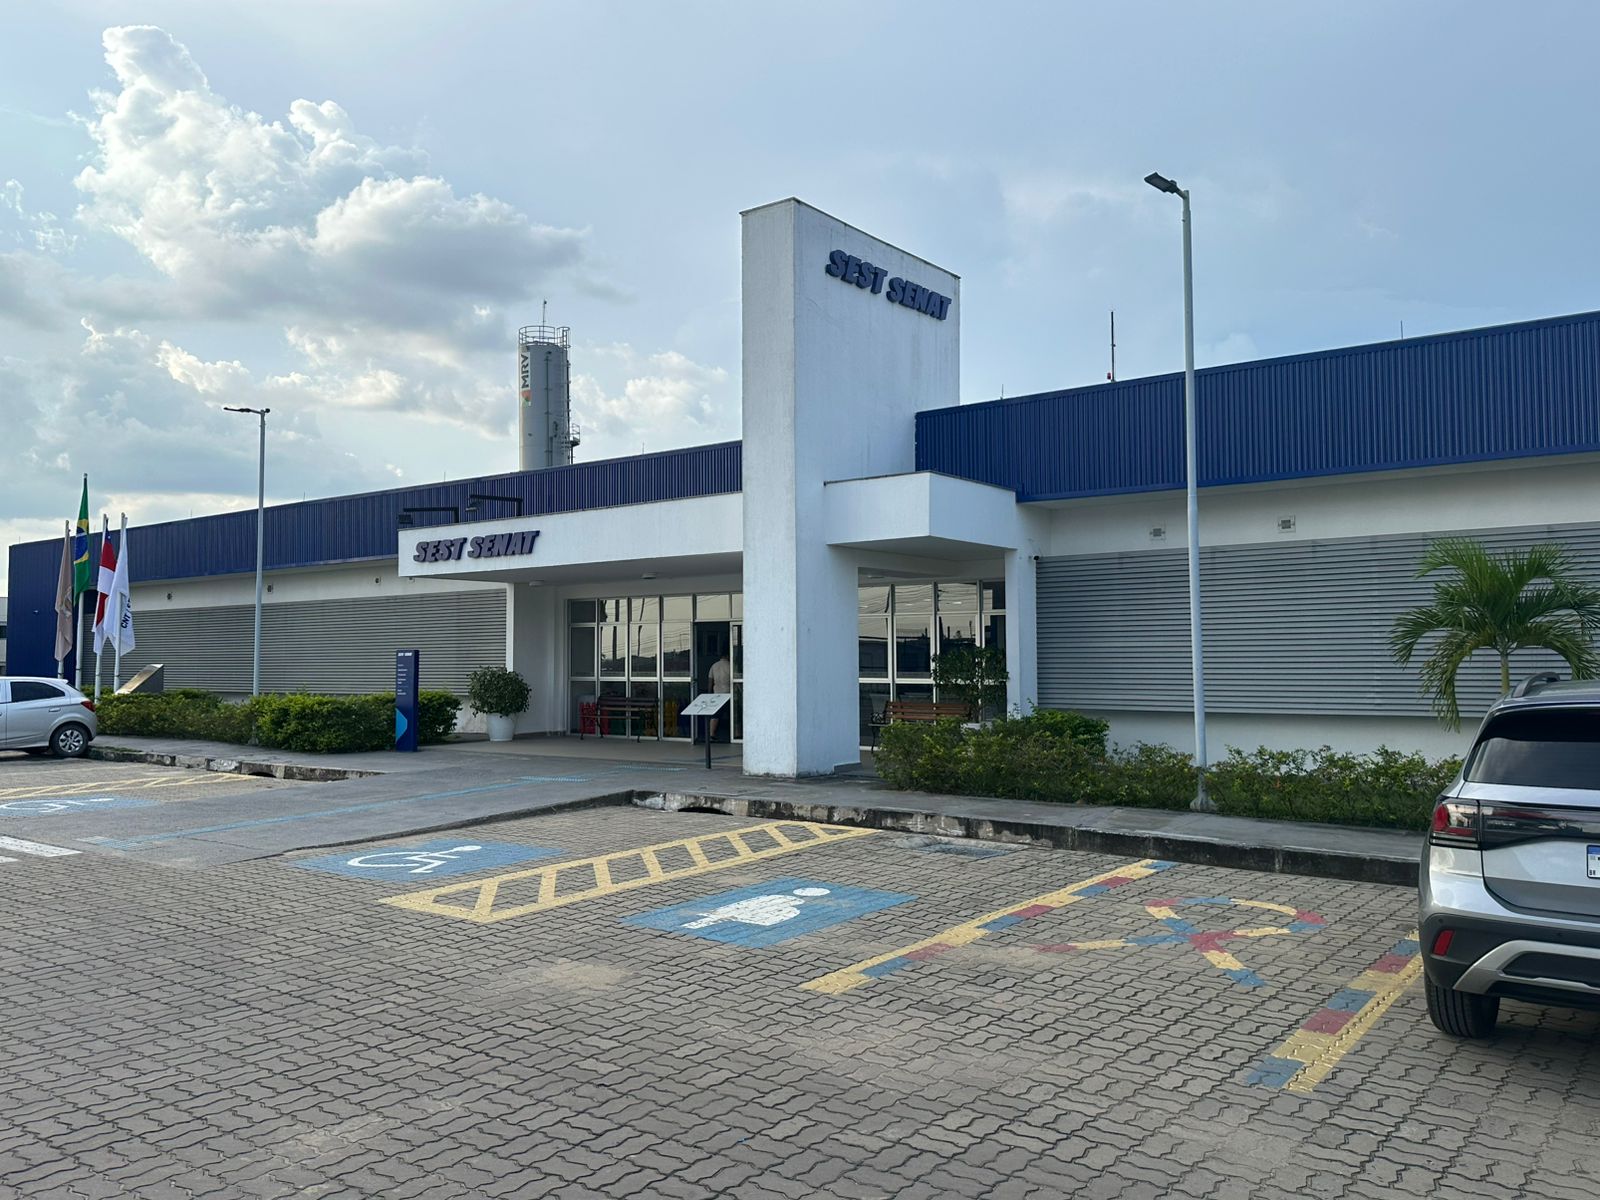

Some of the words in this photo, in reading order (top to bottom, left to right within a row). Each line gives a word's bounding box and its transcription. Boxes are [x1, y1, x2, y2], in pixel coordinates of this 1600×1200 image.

[825, 249, 888, 294] SEST
[886, 277, 952, 321] SENAT
[521, 354, 529, 388] MRV
[413, 537, 468, 562] SEST
[467, 530, 540, 559] SENAT
[121, 613, 131, 628] CNT
